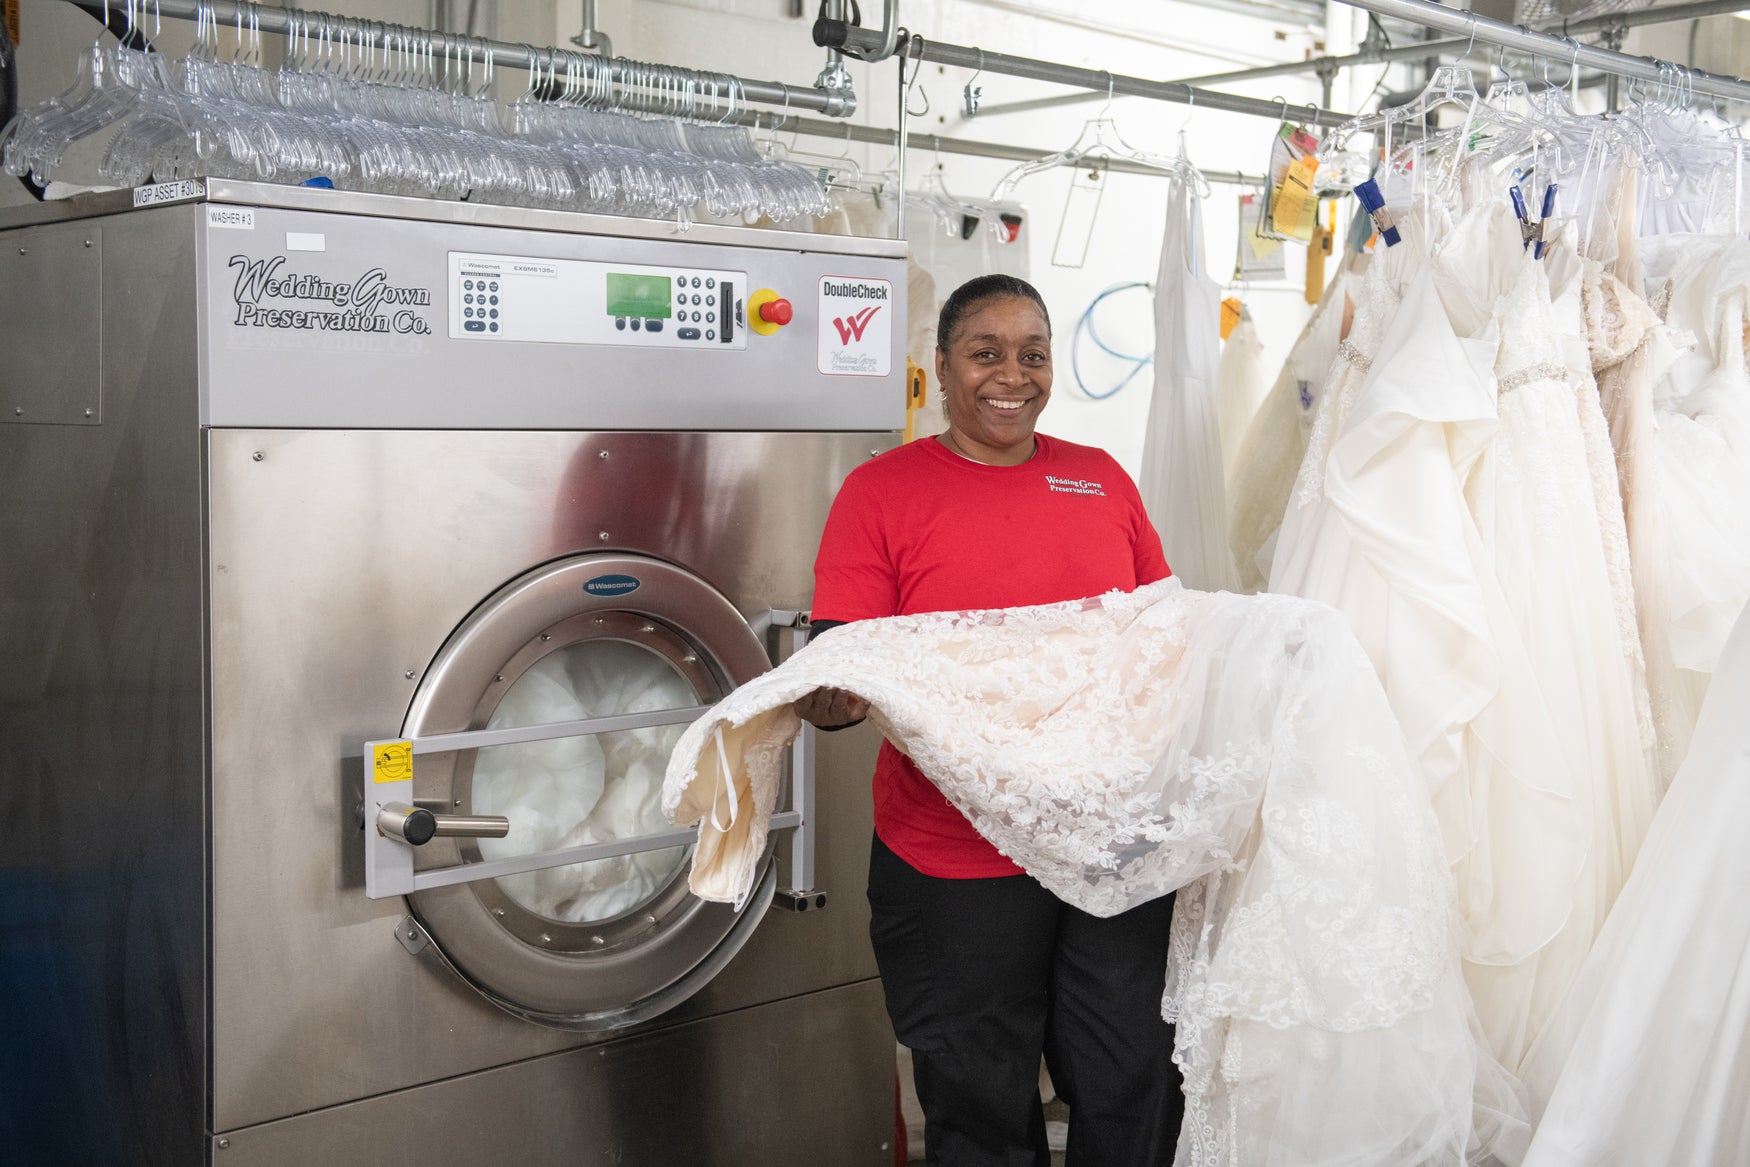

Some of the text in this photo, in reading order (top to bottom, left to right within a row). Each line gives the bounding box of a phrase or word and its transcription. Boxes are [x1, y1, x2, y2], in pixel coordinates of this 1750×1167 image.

[134, 187, 152, 204] WGP
[154, 183, 179, 200] ASSET
[211, 211, 240, 224] WASHER
[228, 254, 350, 307] Wedding
[351, 267, 431, 317] Gown
[823, 281, 887, 300] DoubleCheck
[234, 301, 390, 333] Preservation
[393, 310, 432, 335] Co.
[1045, 475, 1102, 489] Wedding Gown
[1050, 484, 1107, 497] Preservation Co.
[595, 582, 637, 590] Wascomat
